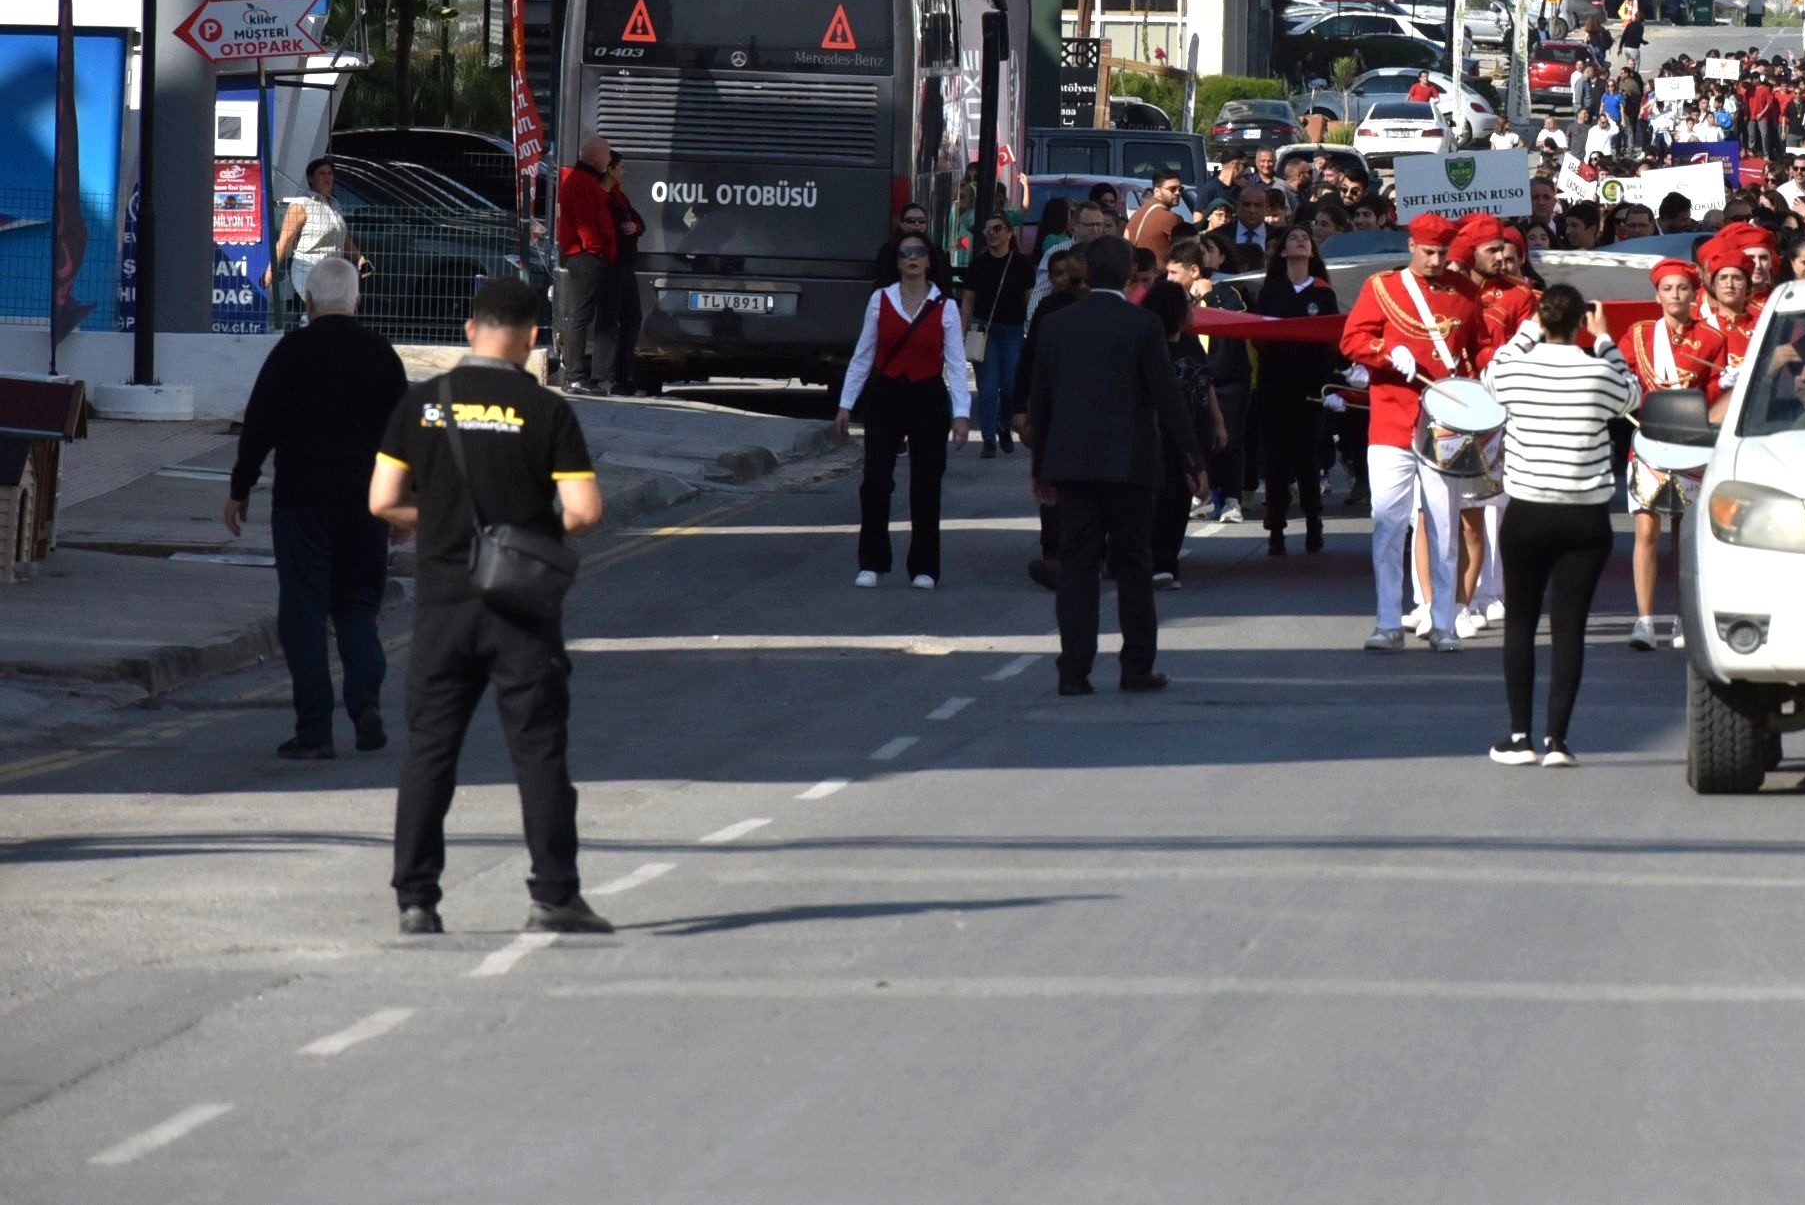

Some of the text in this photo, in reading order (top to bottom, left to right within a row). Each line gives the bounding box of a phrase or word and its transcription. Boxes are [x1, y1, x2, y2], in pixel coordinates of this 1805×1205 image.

[249, 14, 278, 25] kiler
[234, 25, 289, 41] MÜŞTERİ
[220, 38, 304, 56] OTOPARK
[609, 47, 645, 58] 403
[794, 50, 884, 68] Mercedes-Benz
[651, 180, 817, 208] OKUL OTOBÜSÜ
[1402, 187, 1524, 209] ŞHT. HÜSEYİN RUSO
[246, 215, 256, 227] TL
